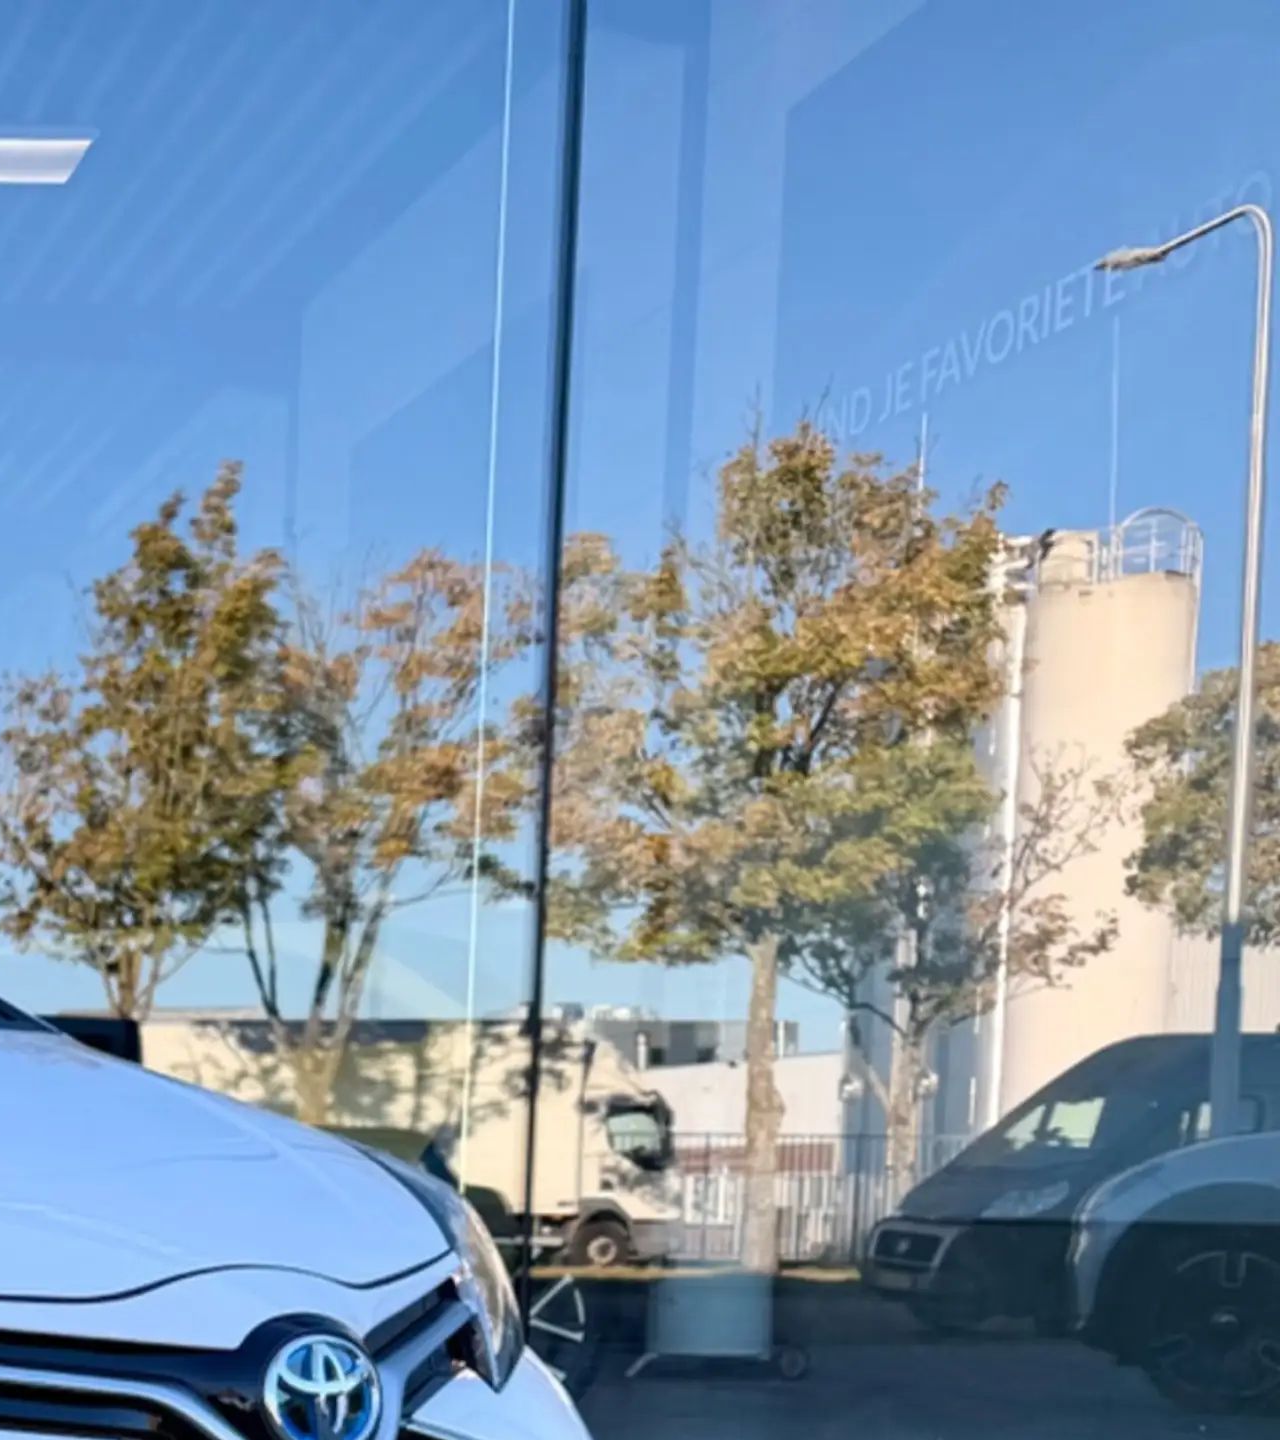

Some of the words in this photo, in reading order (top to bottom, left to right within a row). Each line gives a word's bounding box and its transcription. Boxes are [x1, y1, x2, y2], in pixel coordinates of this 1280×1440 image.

[814, 387, 873, 441] IND
[878, 361, 915, 424] JE
[919, 248, 1127, 403] FAVORIETE
